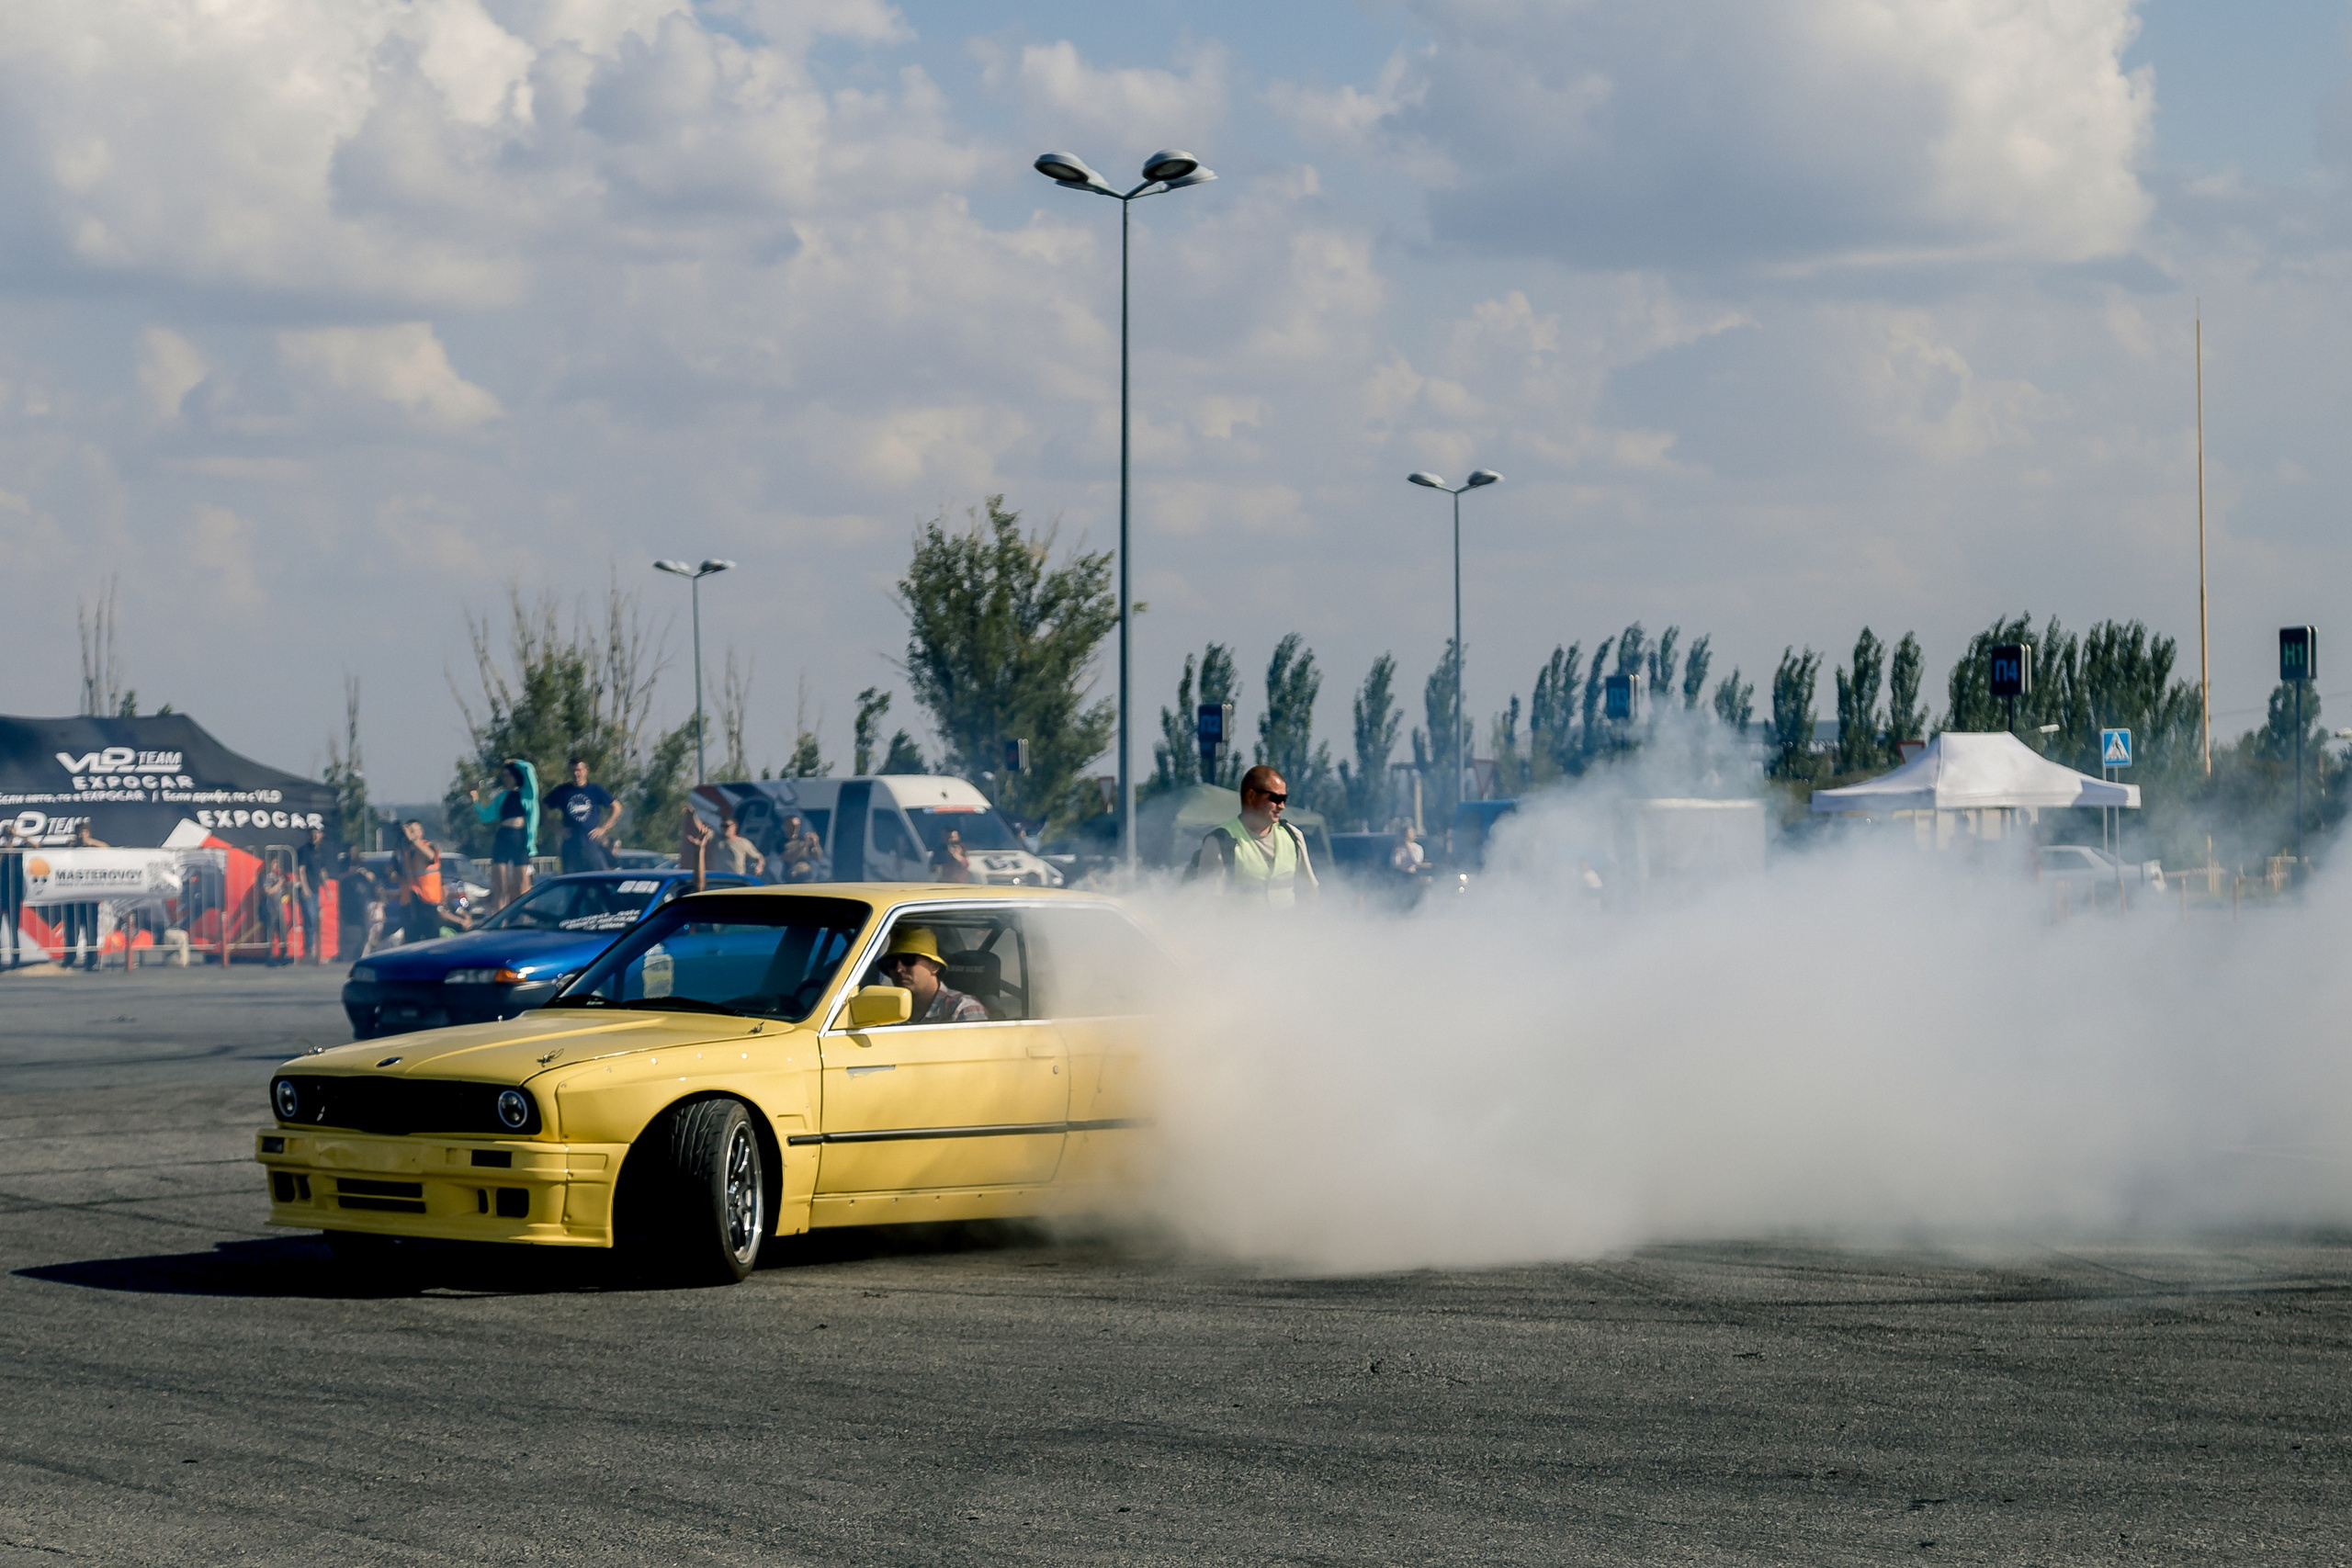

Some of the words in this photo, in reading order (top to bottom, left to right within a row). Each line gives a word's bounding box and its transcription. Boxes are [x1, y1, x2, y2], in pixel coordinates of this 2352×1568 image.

[137, 750, 183, 765] TEAM
[72, 775, 196, 791] EXPOCAR
[81, 790, 147, 803] EXPOCAR
[196, 809, 325, 830] EXPOCAR
[54, 869, 143, 881] MASTEROVOY
